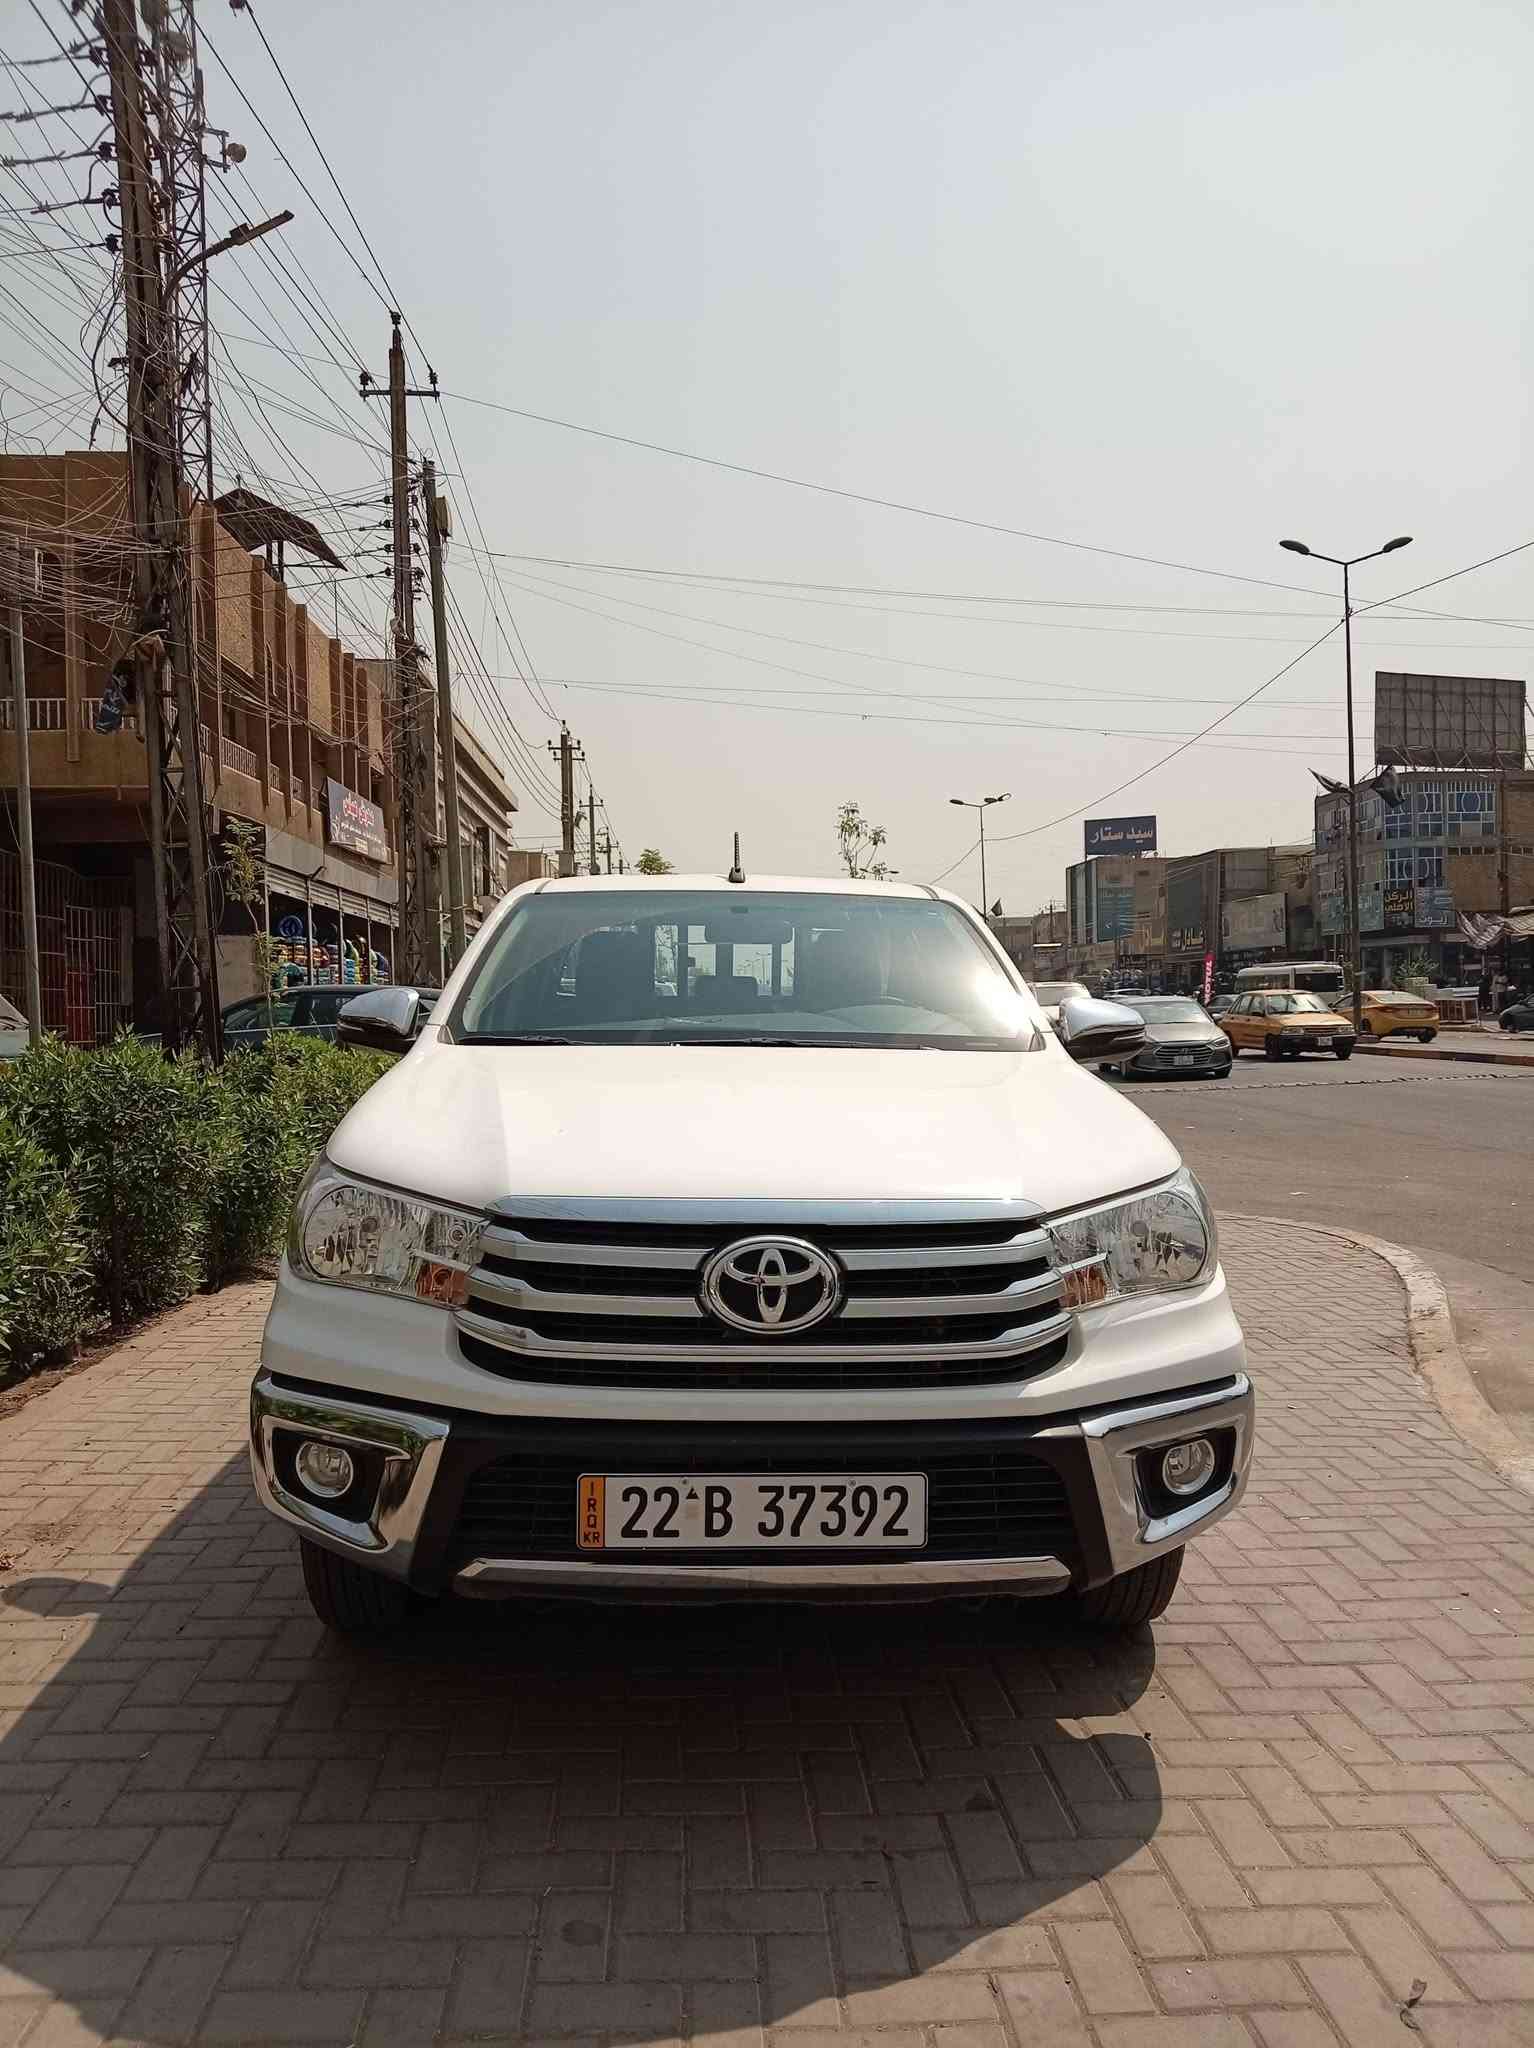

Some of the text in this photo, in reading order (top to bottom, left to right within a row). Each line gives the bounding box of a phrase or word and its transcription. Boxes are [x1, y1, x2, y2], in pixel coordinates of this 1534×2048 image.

[1089, 826, 1153, 844] سيد ستار
[1384, 889, 1414, 903] الركن
[1204, 959, 1213, 1004] MOTUL
[620, 1485, 909, 1539] 22 B 37392
[583, 1531, 600, 1543] KR
